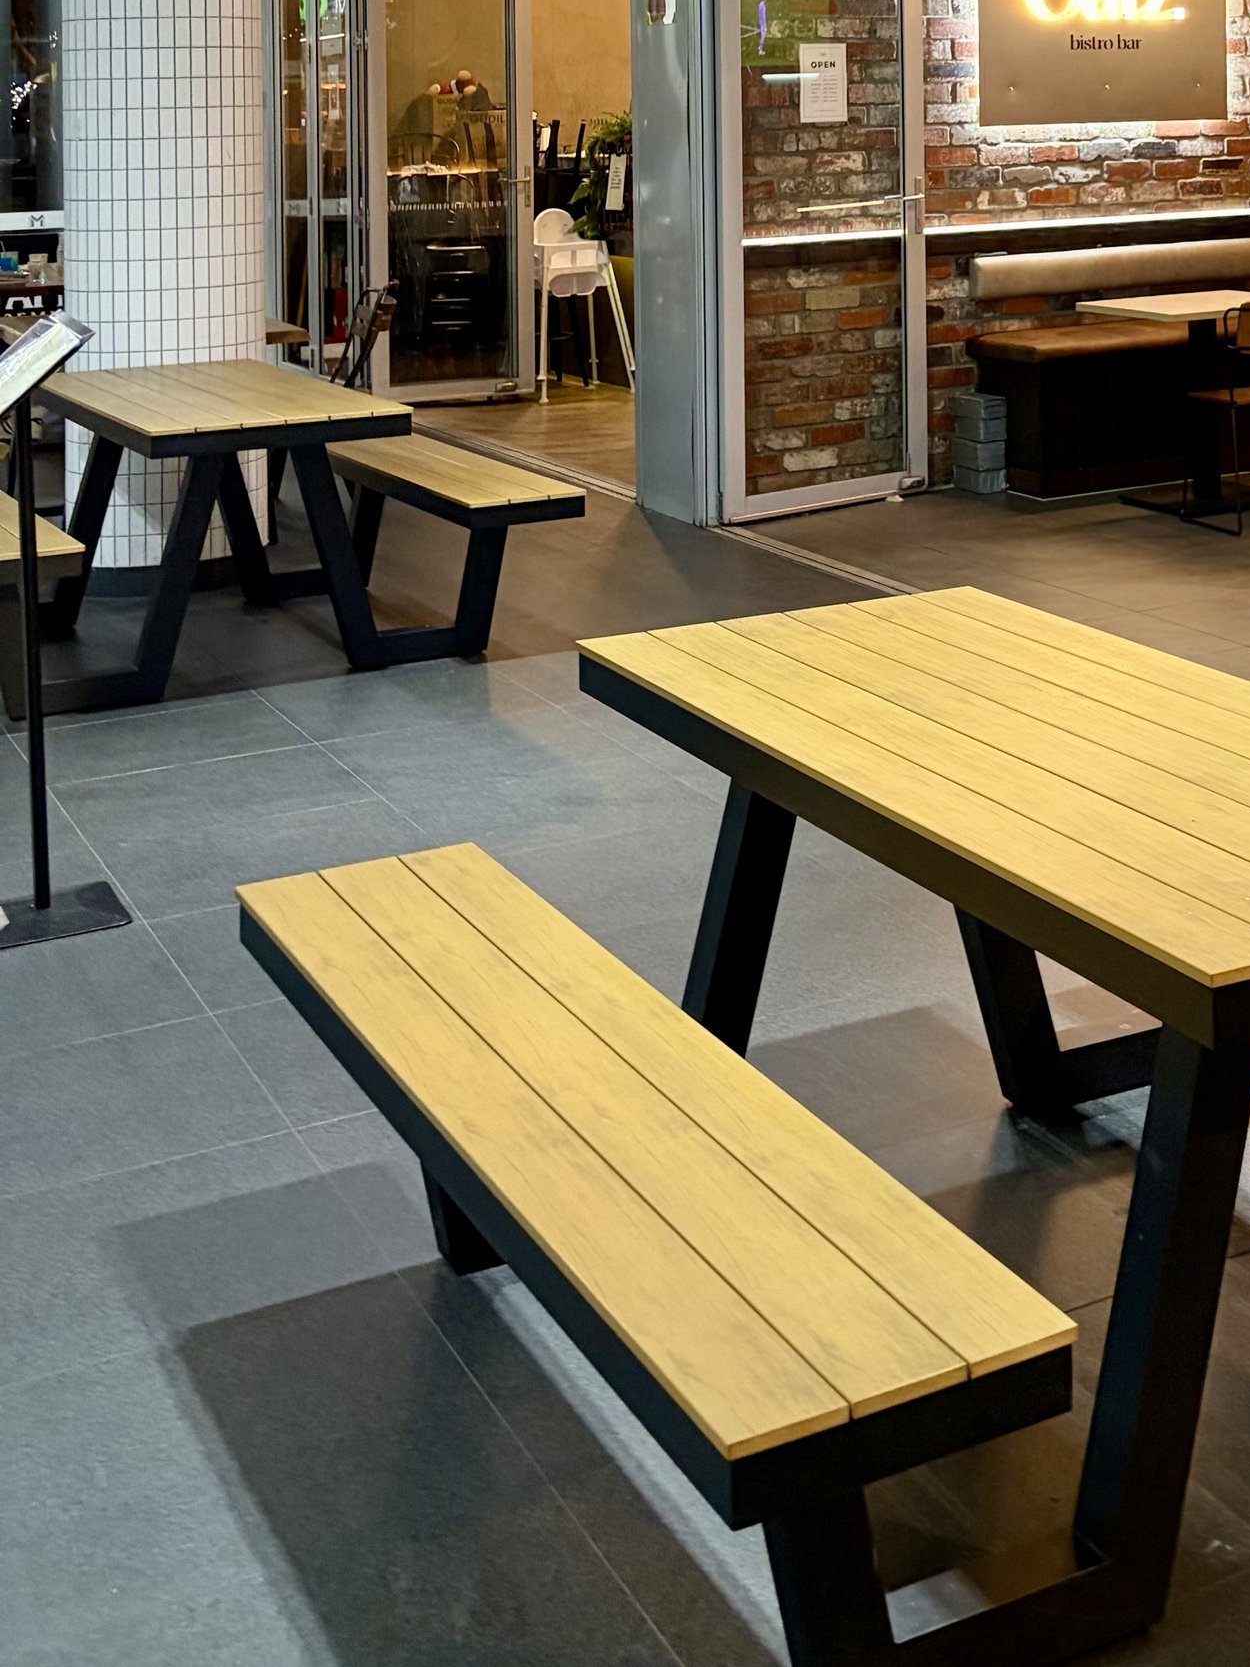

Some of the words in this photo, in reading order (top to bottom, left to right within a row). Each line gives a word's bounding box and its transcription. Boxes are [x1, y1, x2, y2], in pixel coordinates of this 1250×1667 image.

[1070, 34, 1113, 50] bistro
[1117, 34, 1142, 50] bar
[811, 61, 836, 69] OPEN
